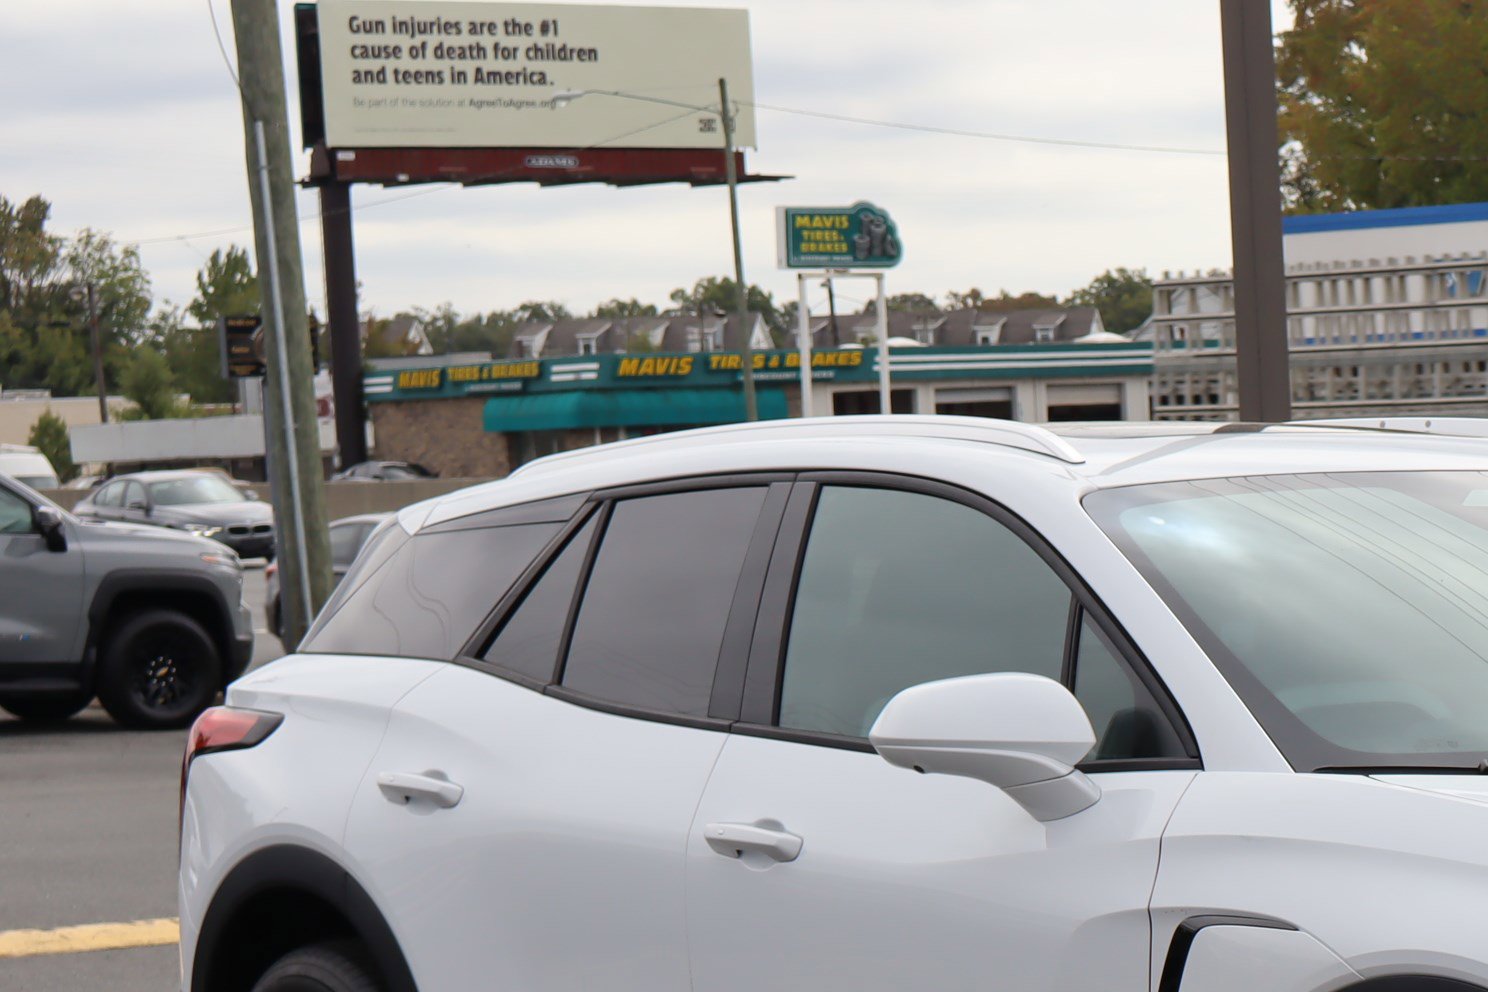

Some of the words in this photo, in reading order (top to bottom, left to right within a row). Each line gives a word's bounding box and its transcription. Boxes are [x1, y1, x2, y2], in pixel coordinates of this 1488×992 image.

[349, 16, 386, 34] Gun
[392, 16, 462, 38] injuries
[468, 21, 497, 36] are
[504, 19, 533, 36] the
[540, 20, 559, 36] #1
[350, 44, 402, 59] cause
[409, 41, 427, 59] of
[434, 42, 487, 60] death
[494, 42, 520, 61] for
[525, 43, 598, 62] children
[352, 66, 387, 84] and
[394, 68, 445, 85] teens
[450, 67, 468, 85] in
[474, 67, 554, 86] America.
[353, 98, 366, 107] Be
[369, 98, 387, 110] part
[389, 98, 399, 107] of
[401, 98, 416, 107] the
[419, 98, 454, 107] solution
[795, 214, 849, 229] MAVIS
[801, 230, 838, 241] TIRES
[801, 242, 848, 253] BRAKES
[618, 356, 695, 376] MAVIS
[709, 353, 765, 369] TIRS
[768, 355, 781, 368] &
[785, 351, 863, 369] BAKES
[399, 369, 441, 388] MAVIS
[447, 366, 480, 381] TIRES
[492, 362, 539, 379] BRAKES
